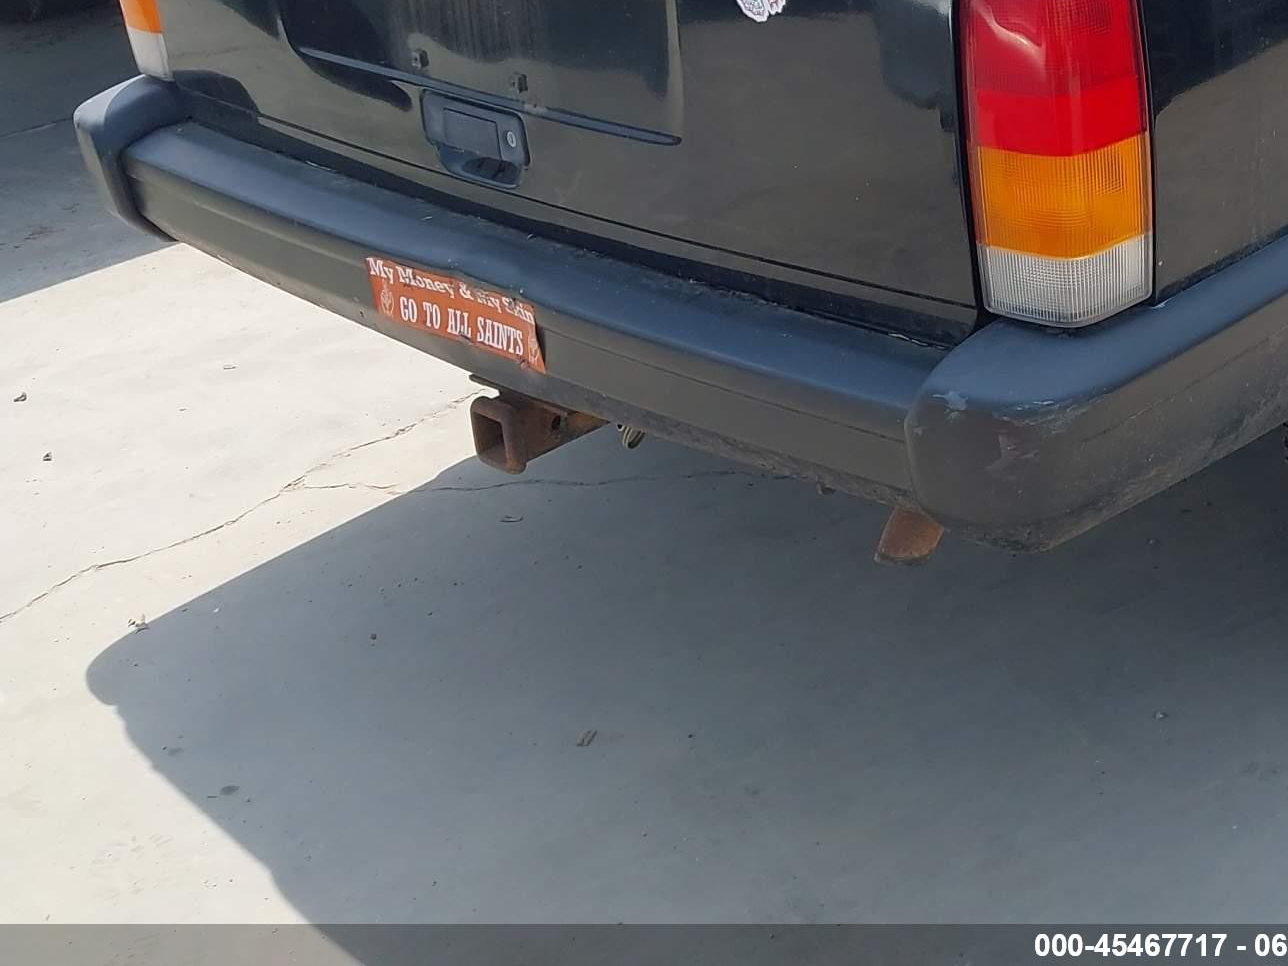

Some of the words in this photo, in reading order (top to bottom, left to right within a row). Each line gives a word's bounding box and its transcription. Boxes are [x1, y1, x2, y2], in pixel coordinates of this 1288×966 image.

[366, 257, 395, 284] My
[395, 265, 455, 298] Money
[459, 281, 475, 301] &
[399, 295, 418, 323] GO
[423, 301, 441, 330] TO
[446, 308, 472, 339] ALL
[477, 316, 524, 356] SAINTS
